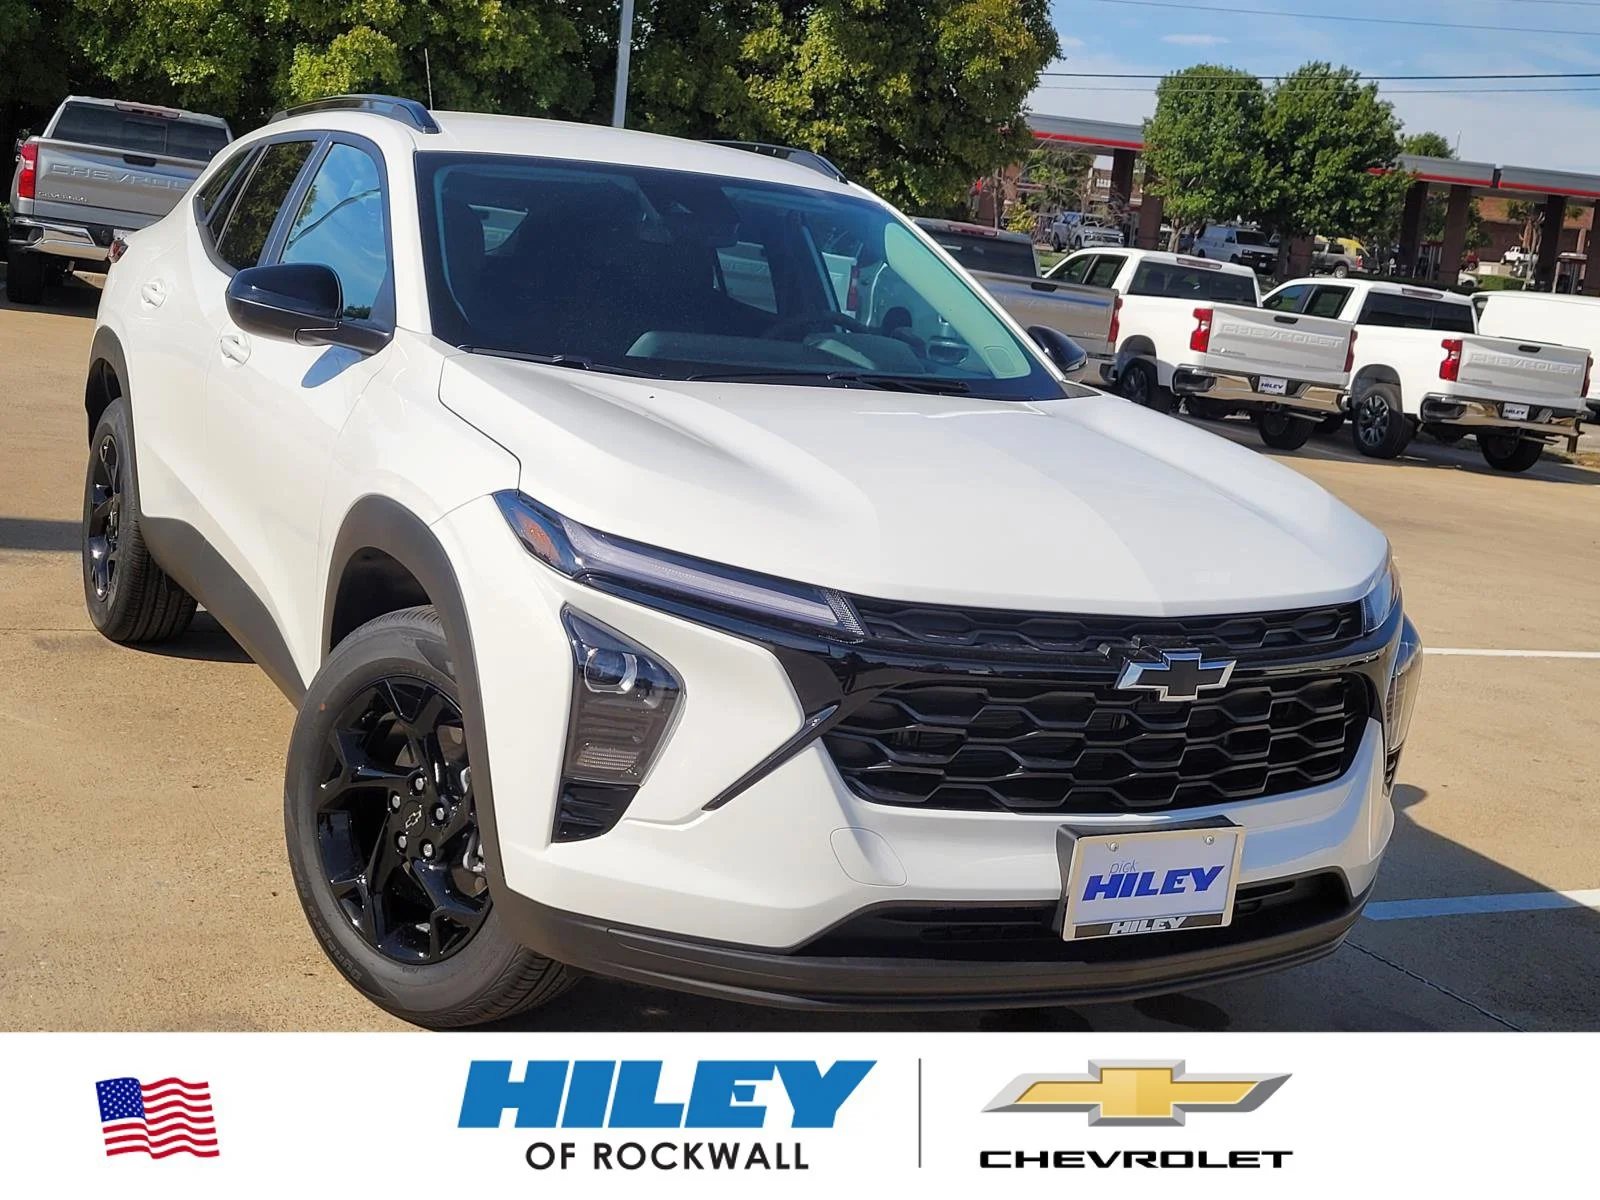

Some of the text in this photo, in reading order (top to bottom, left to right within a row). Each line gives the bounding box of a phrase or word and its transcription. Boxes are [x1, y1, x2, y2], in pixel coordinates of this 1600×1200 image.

[1221, 323, 1343, 348] CHEVROLET
[1471, 353, 1582, 375] CHEVROLET
[1109, 859, 1138, 874] pick
[1081, 865, 1225, 902] HILEY
[1109, 916, 1187, 935] HILEY
